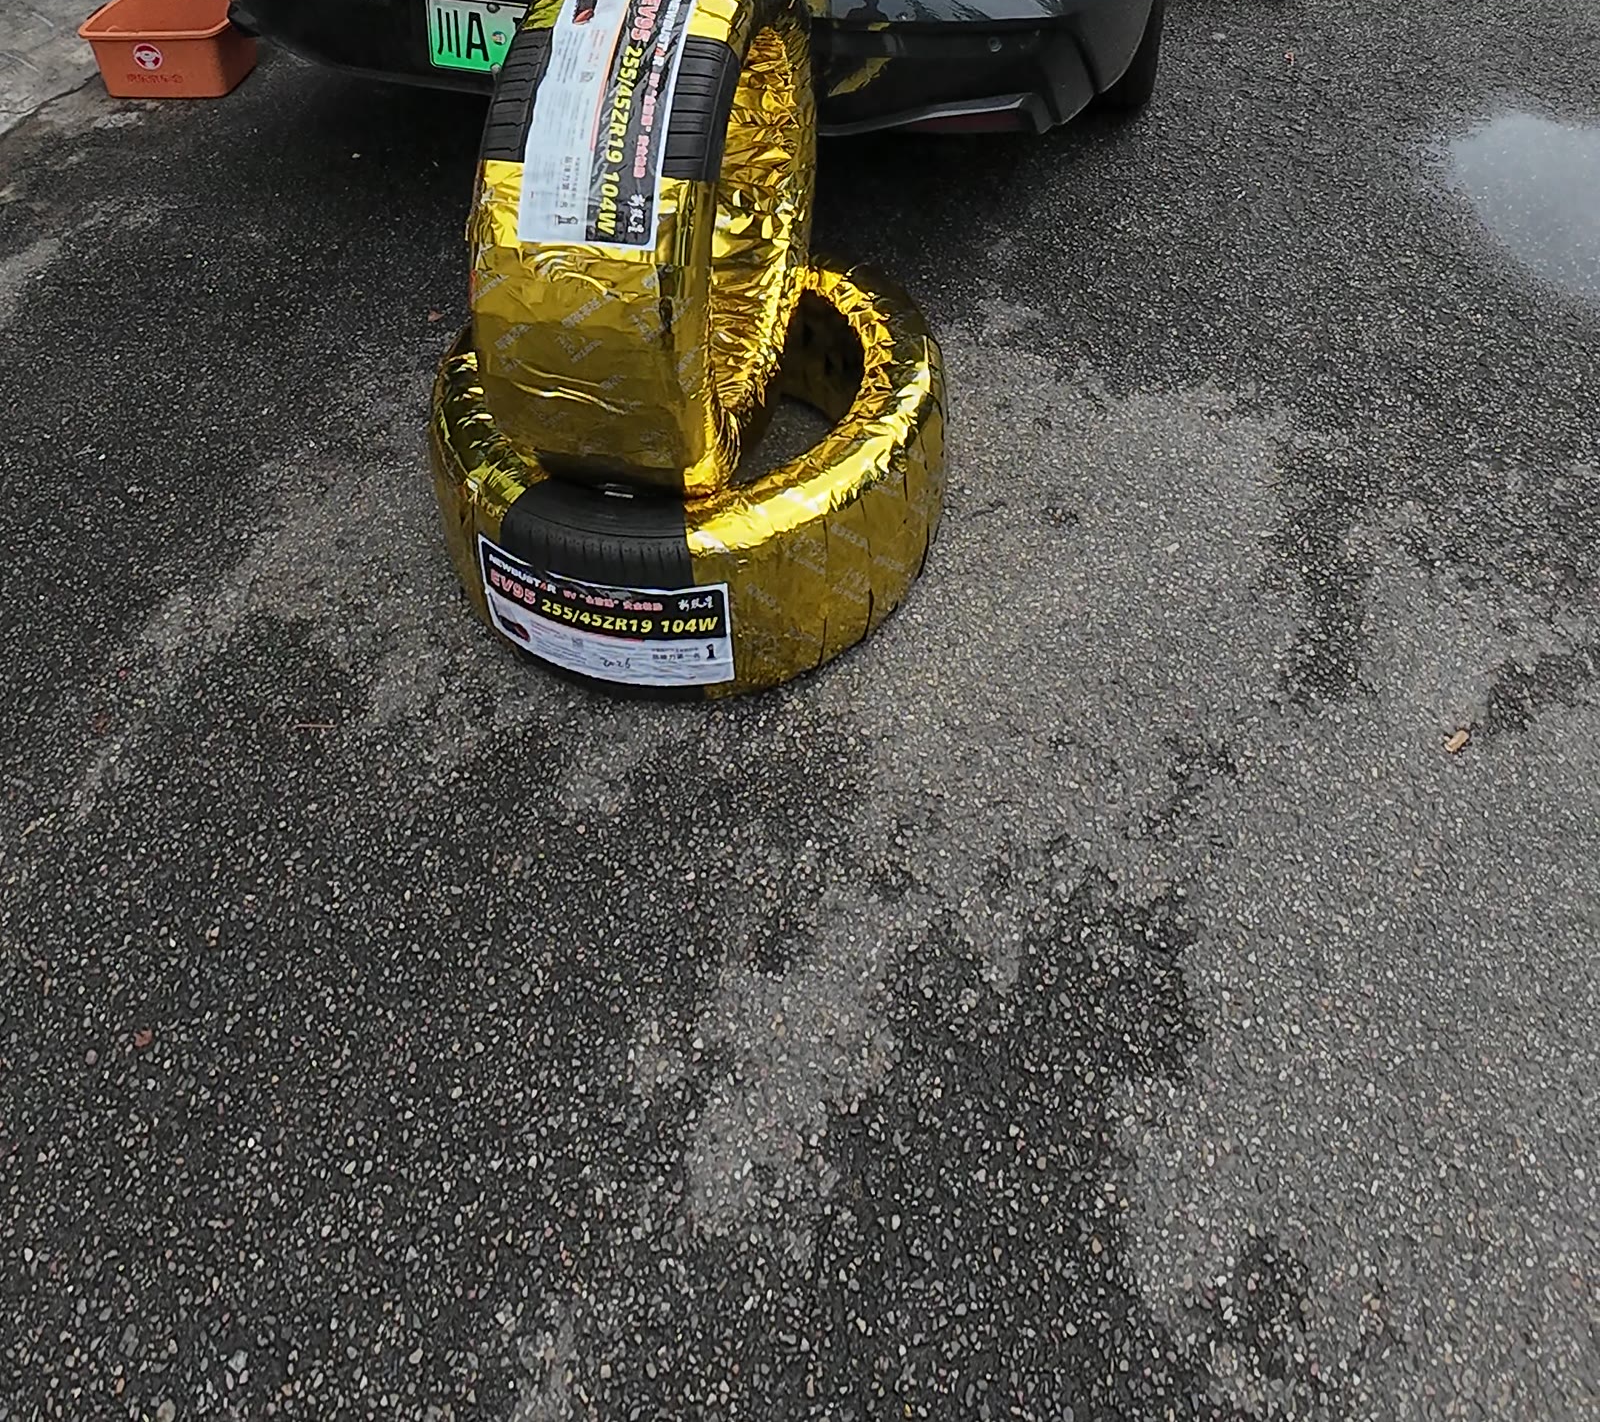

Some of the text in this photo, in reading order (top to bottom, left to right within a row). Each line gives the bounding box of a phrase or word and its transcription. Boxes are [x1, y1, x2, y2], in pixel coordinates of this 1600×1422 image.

[436, 7, 521, 62] 川A
[605, 45, 643, 164] 255/45ZR19
[597, 172, 620, 236] 104W
[489, 553, 557, 595] NEWBUSTAR
[489, 568, 536, 605] EV95
[541, 598, 653, 633] 255/45ZR19
[660, 616, 718, 633] 104W
